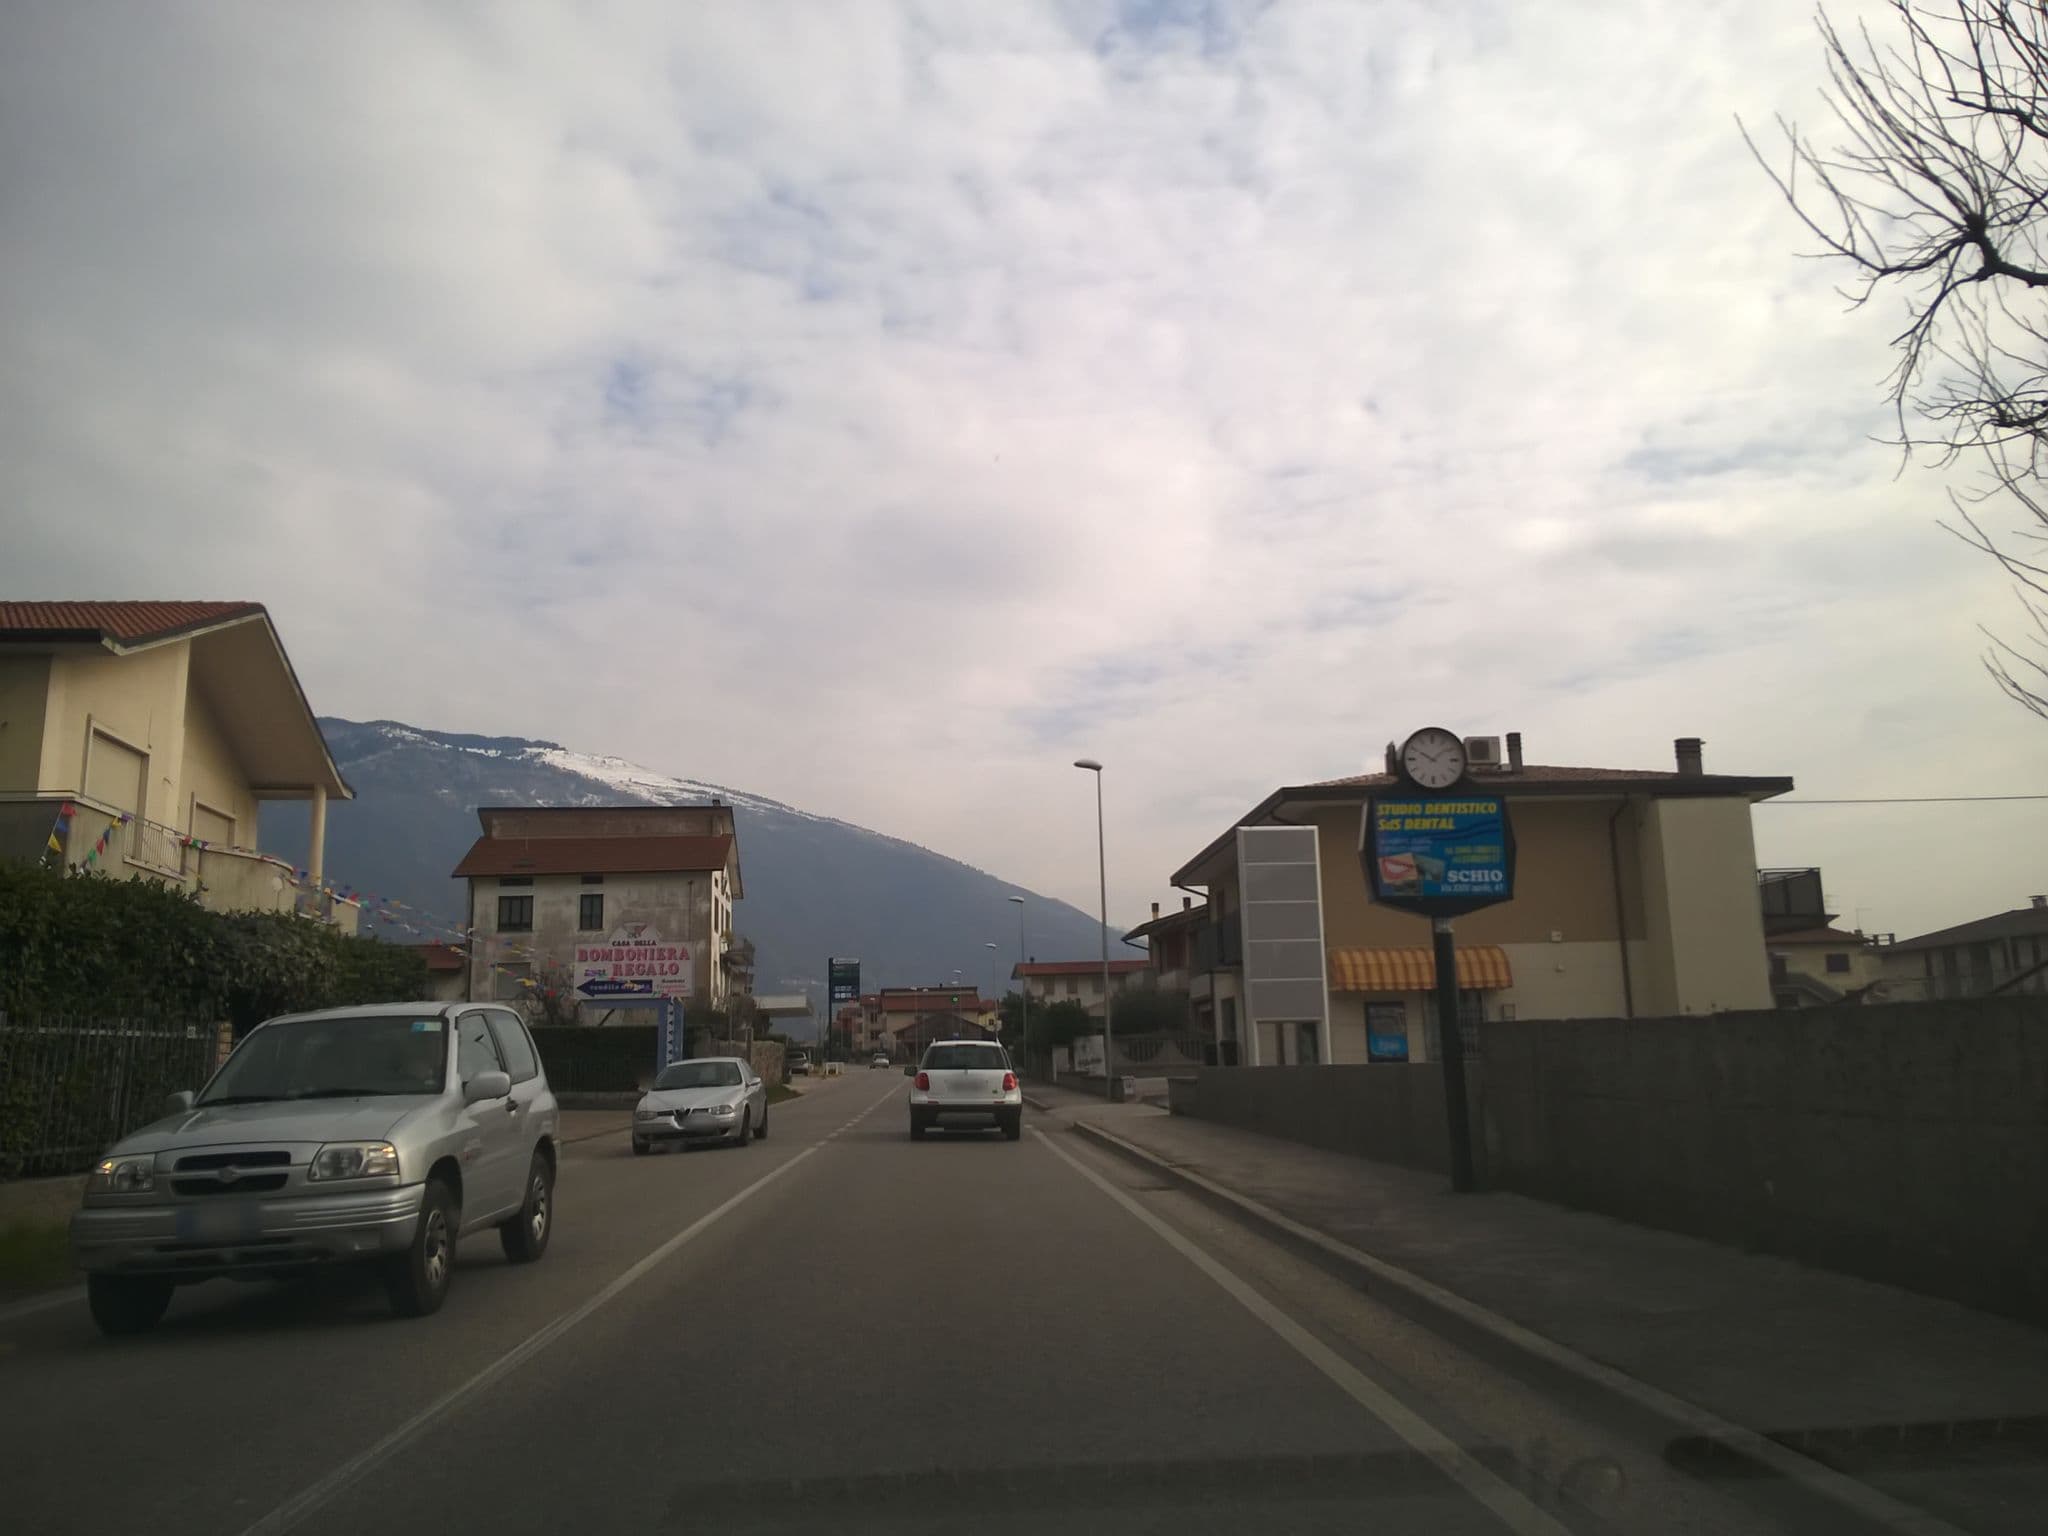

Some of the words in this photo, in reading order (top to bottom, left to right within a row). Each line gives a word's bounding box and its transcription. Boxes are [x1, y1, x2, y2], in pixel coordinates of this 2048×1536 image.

[1376, 803, 1422, 816] STUDIO
[1424, 802, 1497, 815] DENTISTICO
[1404, 817, 1456, 830] DENTAL
[1447, 869, 1502, 882] SCHIO
[578, 947, 690, 962] BOMBONIERA
[612, 963, 680, 977] REGALO
